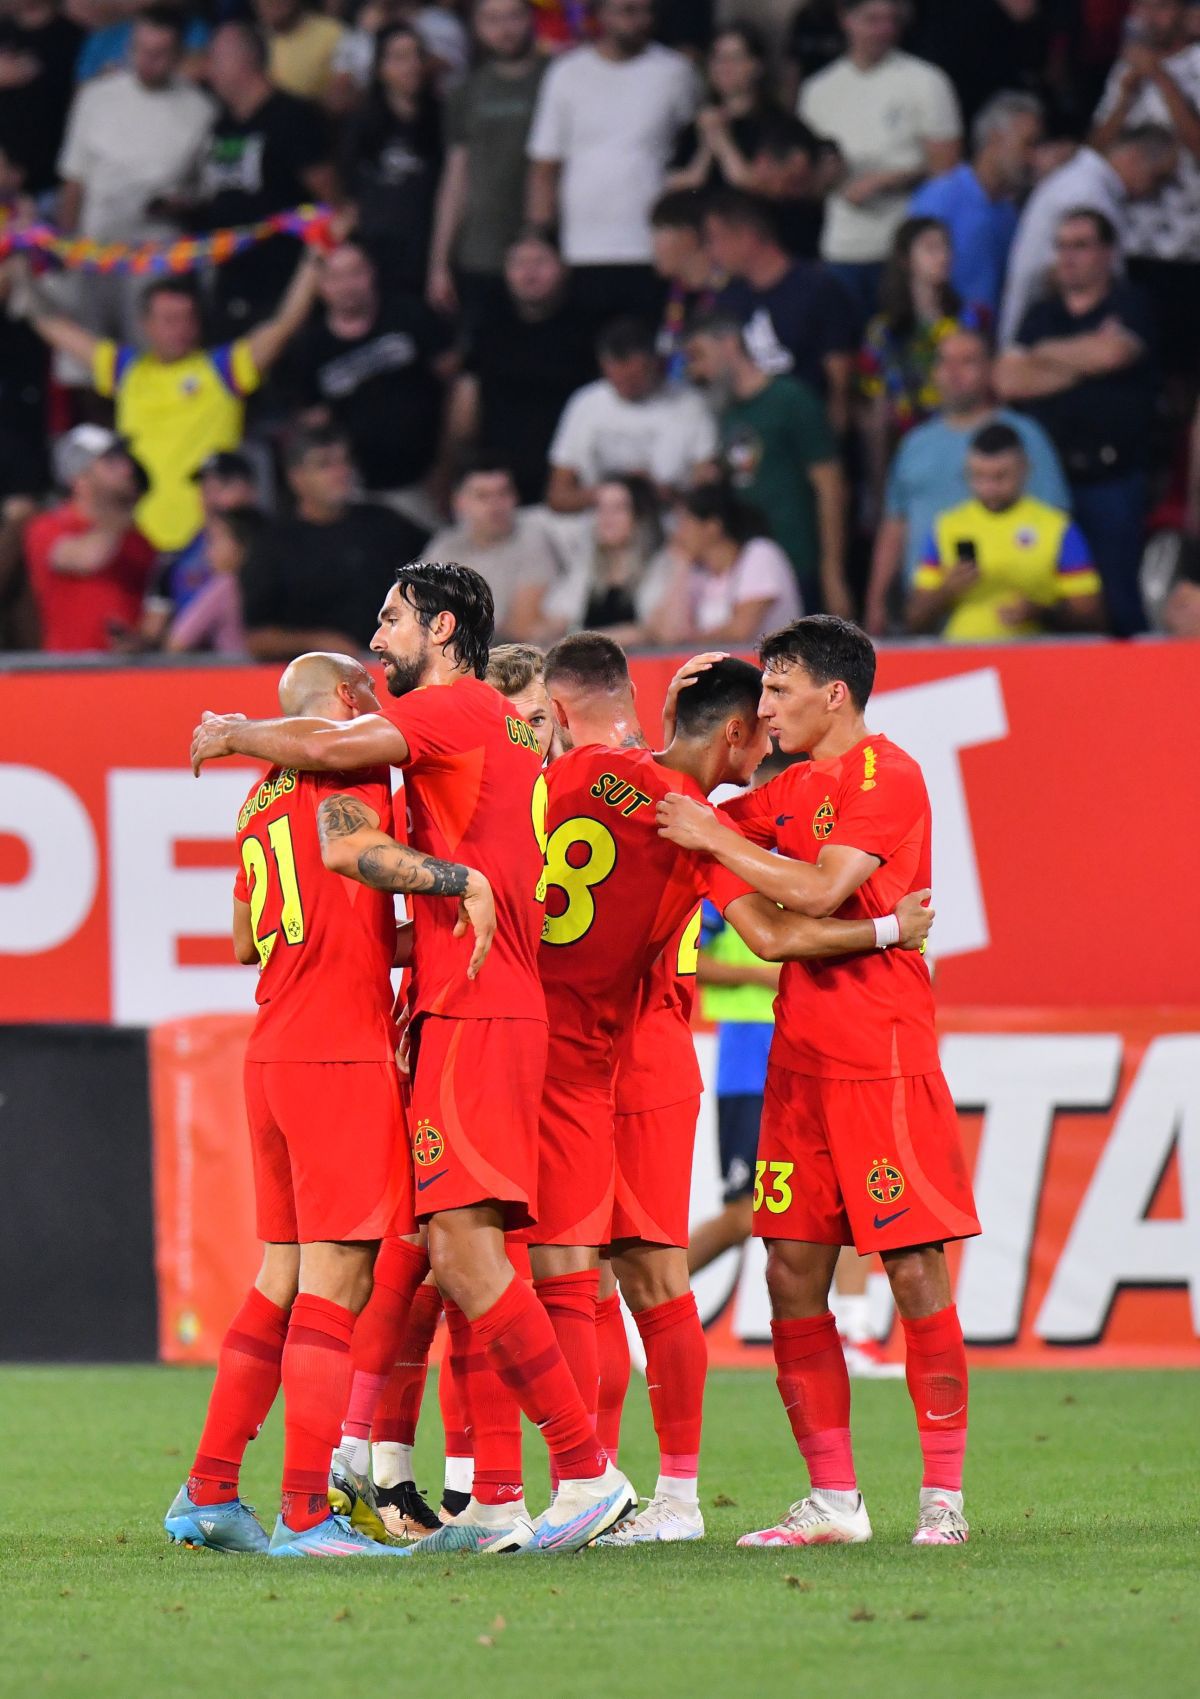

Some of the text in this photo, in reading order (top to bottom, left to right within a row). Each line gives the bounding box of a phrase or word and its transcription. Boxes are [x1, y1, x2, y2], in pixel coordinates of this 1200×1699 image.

[590, 772, 652, 817] SUT
[241, 813, 304, 970] 21
[540, 816, 619, 948] 8
